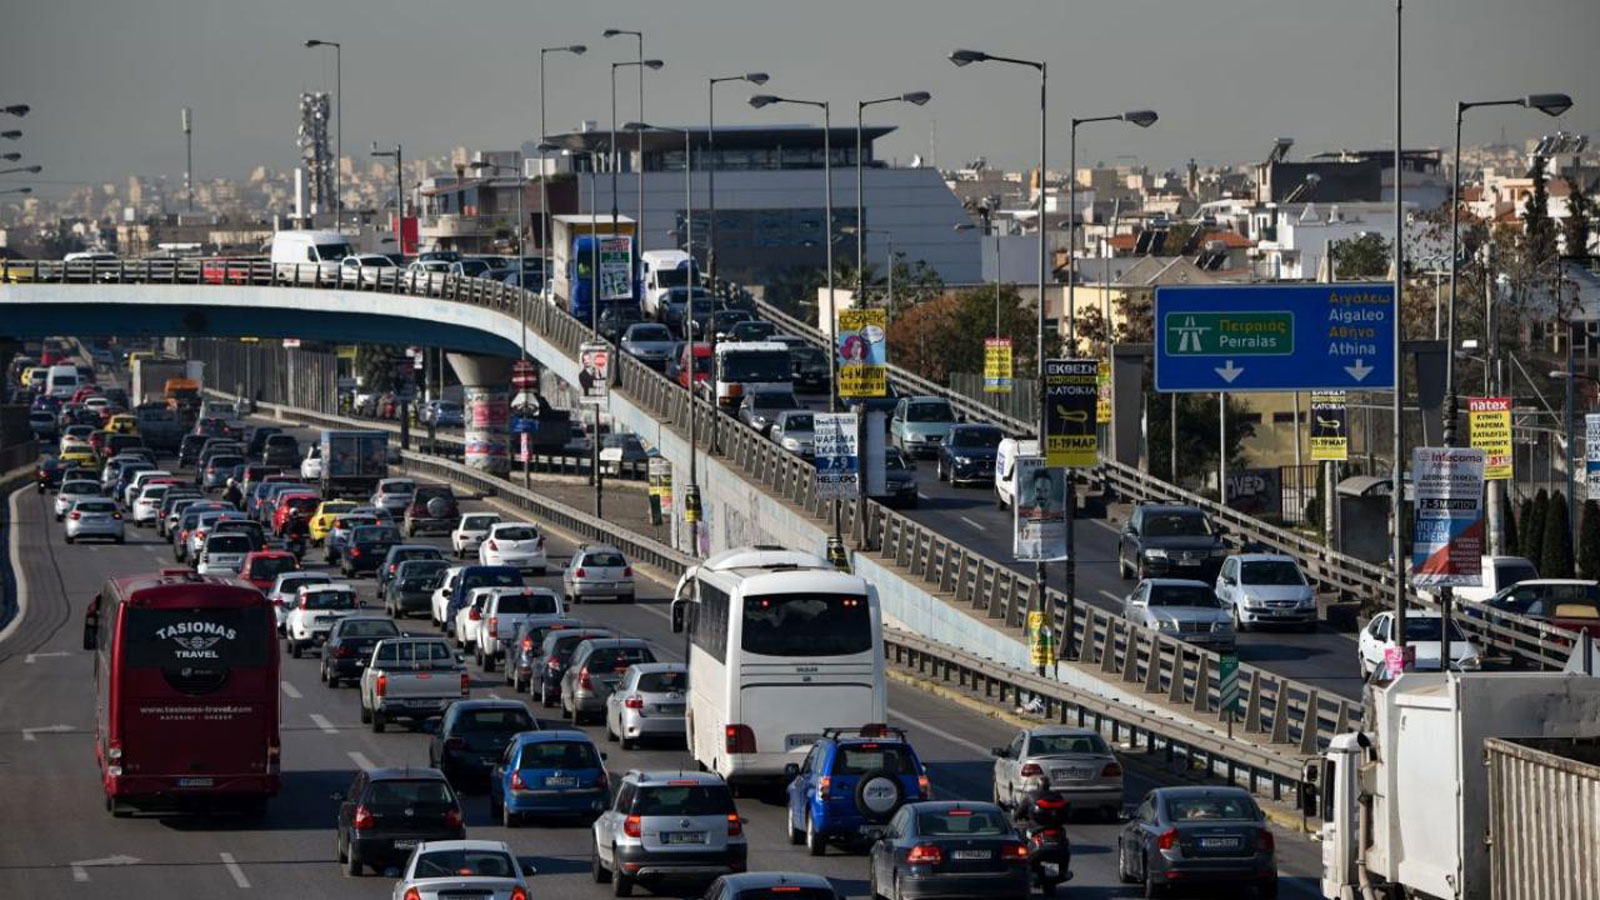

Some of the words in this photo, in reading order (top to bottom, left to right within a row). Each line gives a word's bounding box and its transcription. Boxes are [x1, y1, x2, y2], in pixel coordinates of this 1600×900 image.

[1329, 308, 1384, 323] Aigaleo
[1219, 335, 1277, 347] Peiraias
[1329, 342, 1376, 355] Athina
[1048, 364, 1096, 374] ΕΚΘΕΣΗ
[1048, 386, 1096, 395] ΚΑΤΟΙΚΙΑ
[1470, 400, 1507, 410] natex
[156, 622, 237, 640] TASIONAS
